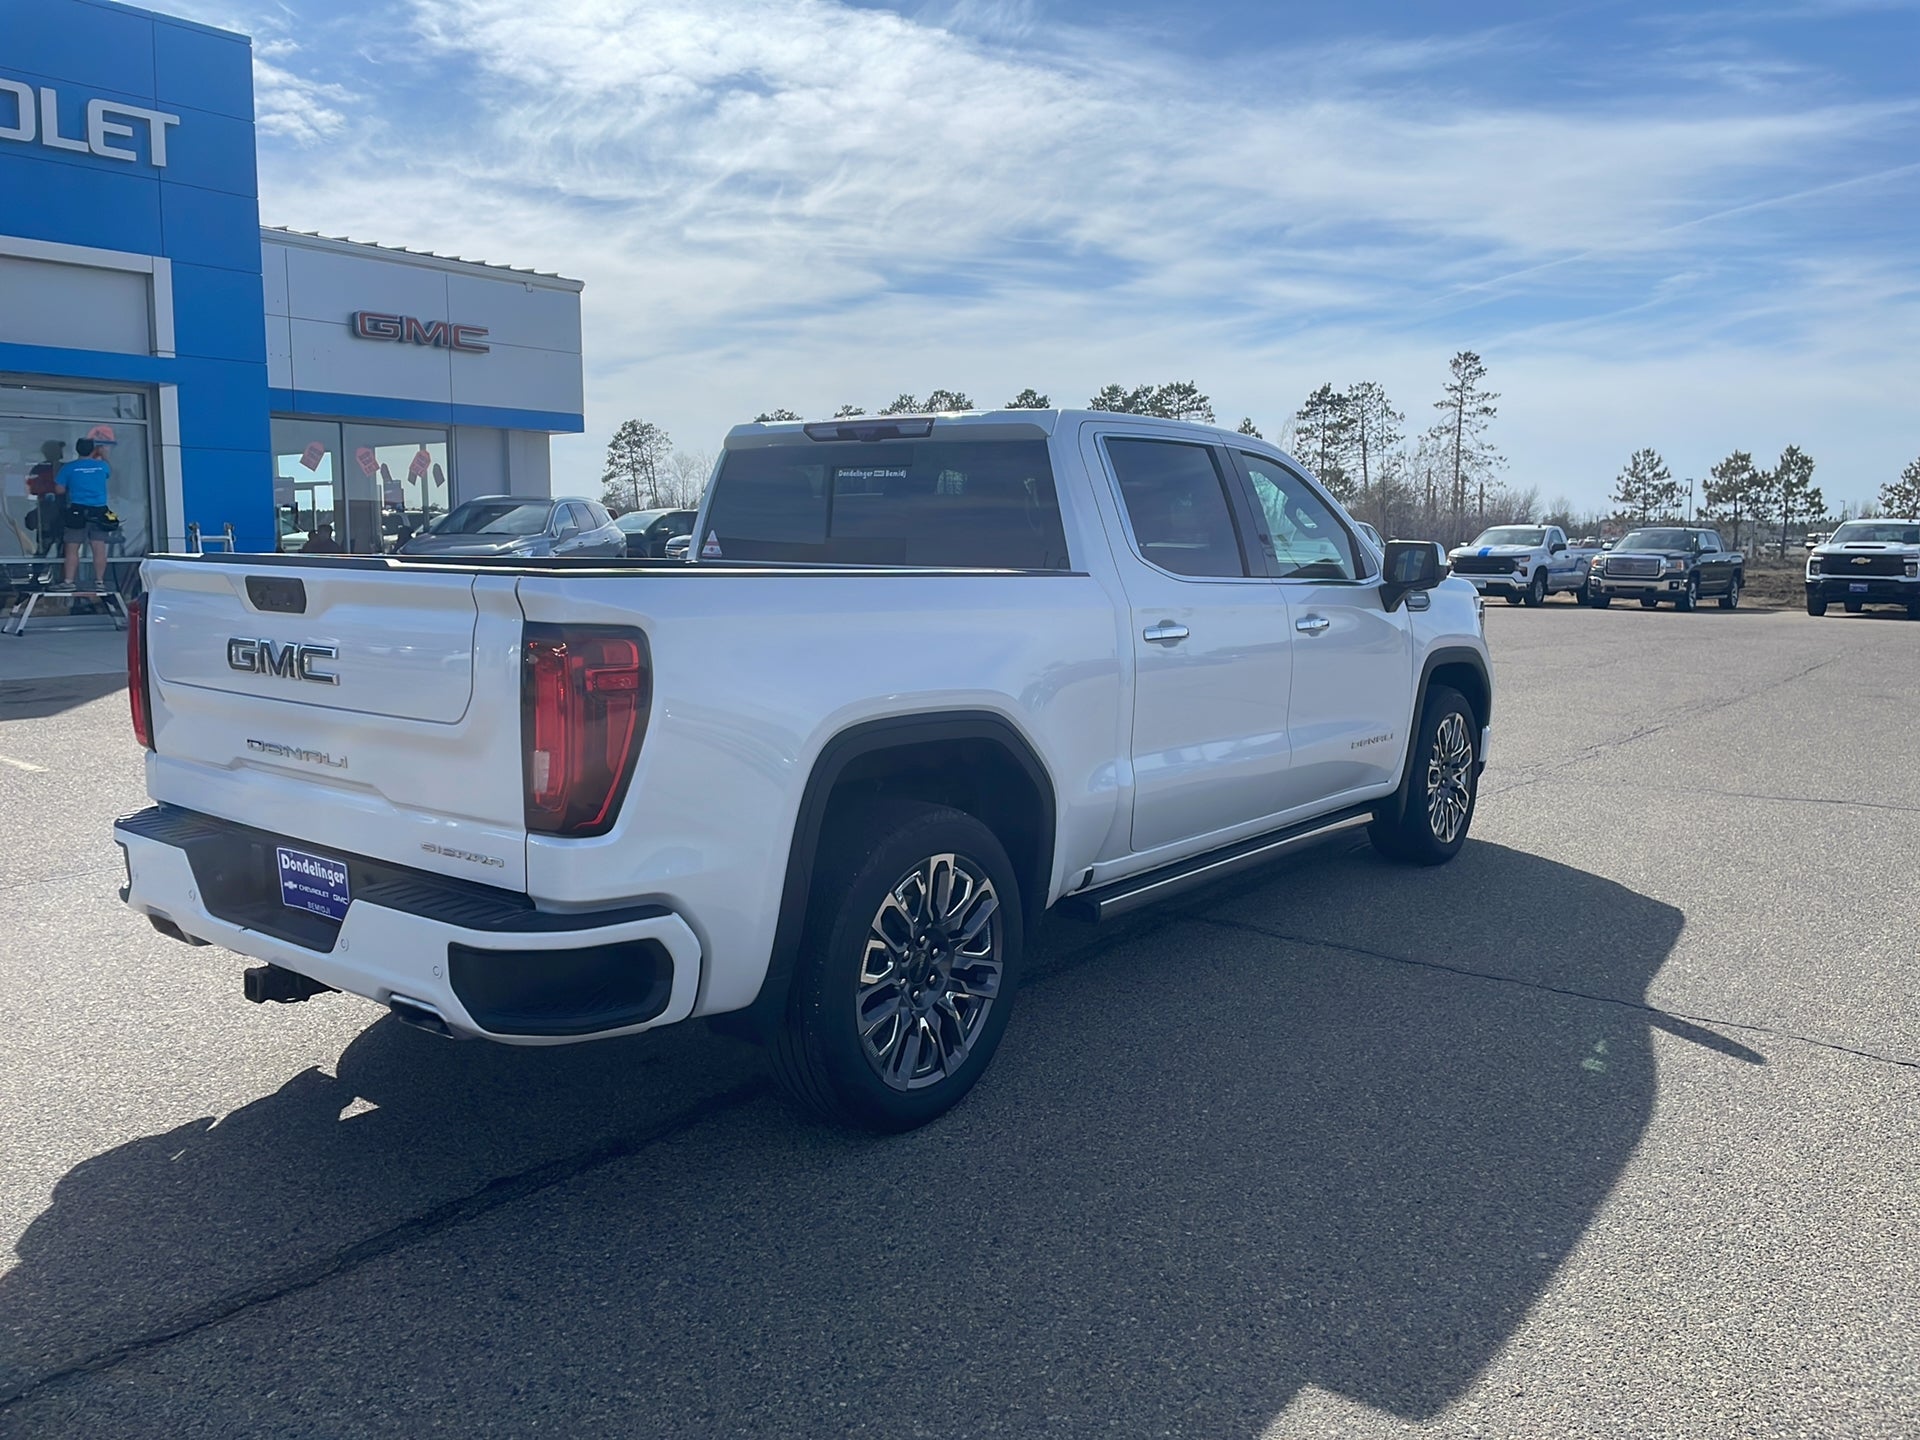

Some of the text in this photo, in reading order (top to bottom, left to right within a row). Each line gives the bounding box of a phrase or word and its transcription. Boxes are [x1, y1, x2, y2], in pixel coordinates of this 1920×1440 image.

[353, 310, 490, 353] GMC
[227, 637, 341, 686] GMC
[246, 738, 348, 769] DENALI
[280, 853, 345, 887] Dondelinger
[298, 884, 348, 905] CHEVROLET GMC
